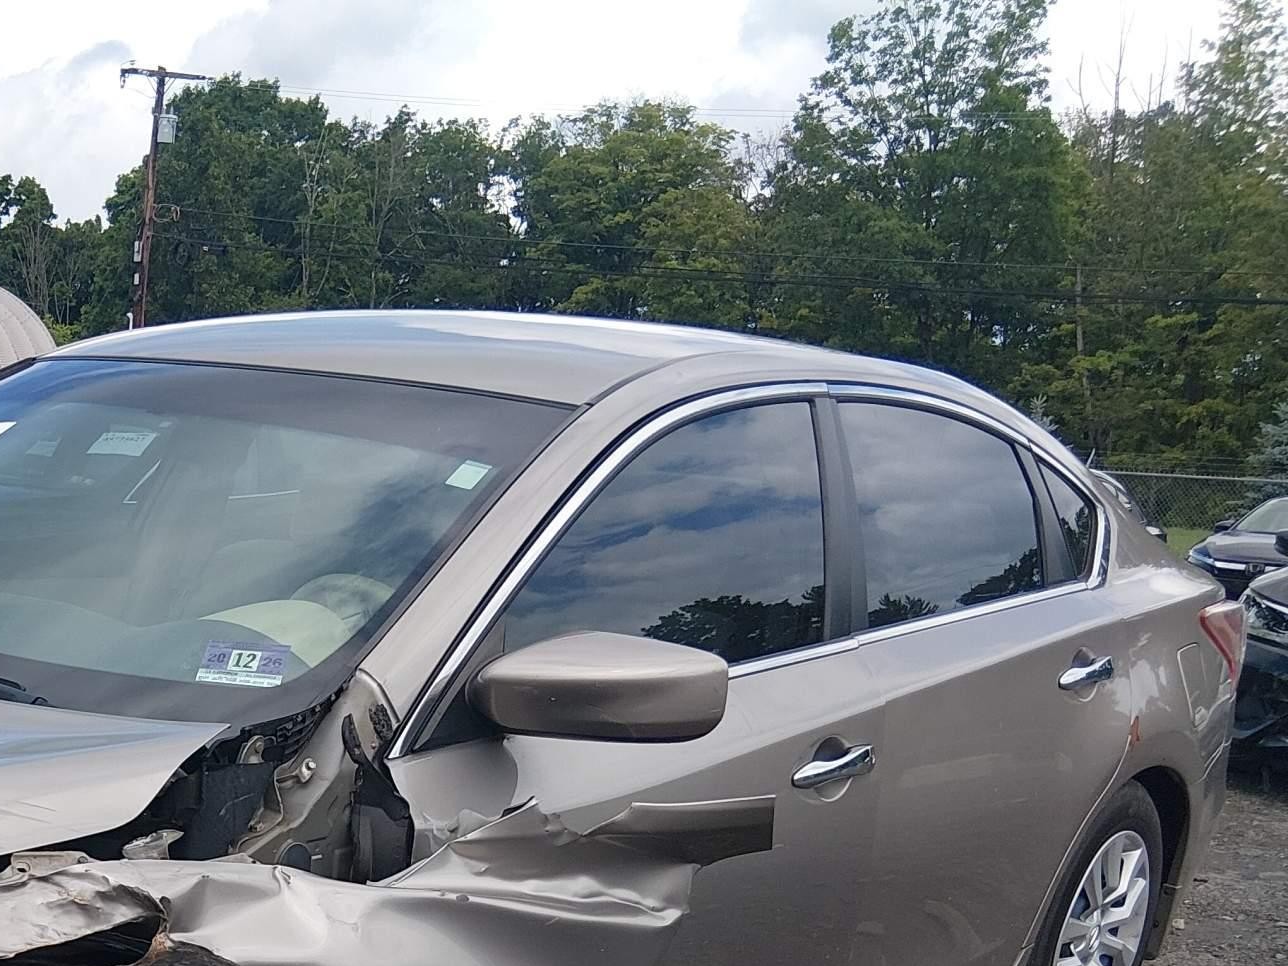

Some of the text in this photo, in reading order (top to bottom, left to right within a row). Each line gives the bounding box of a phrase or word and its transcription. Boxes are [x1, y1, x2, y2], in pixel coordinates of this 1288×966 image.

[207, 652, 283, 669] 20 12 26
